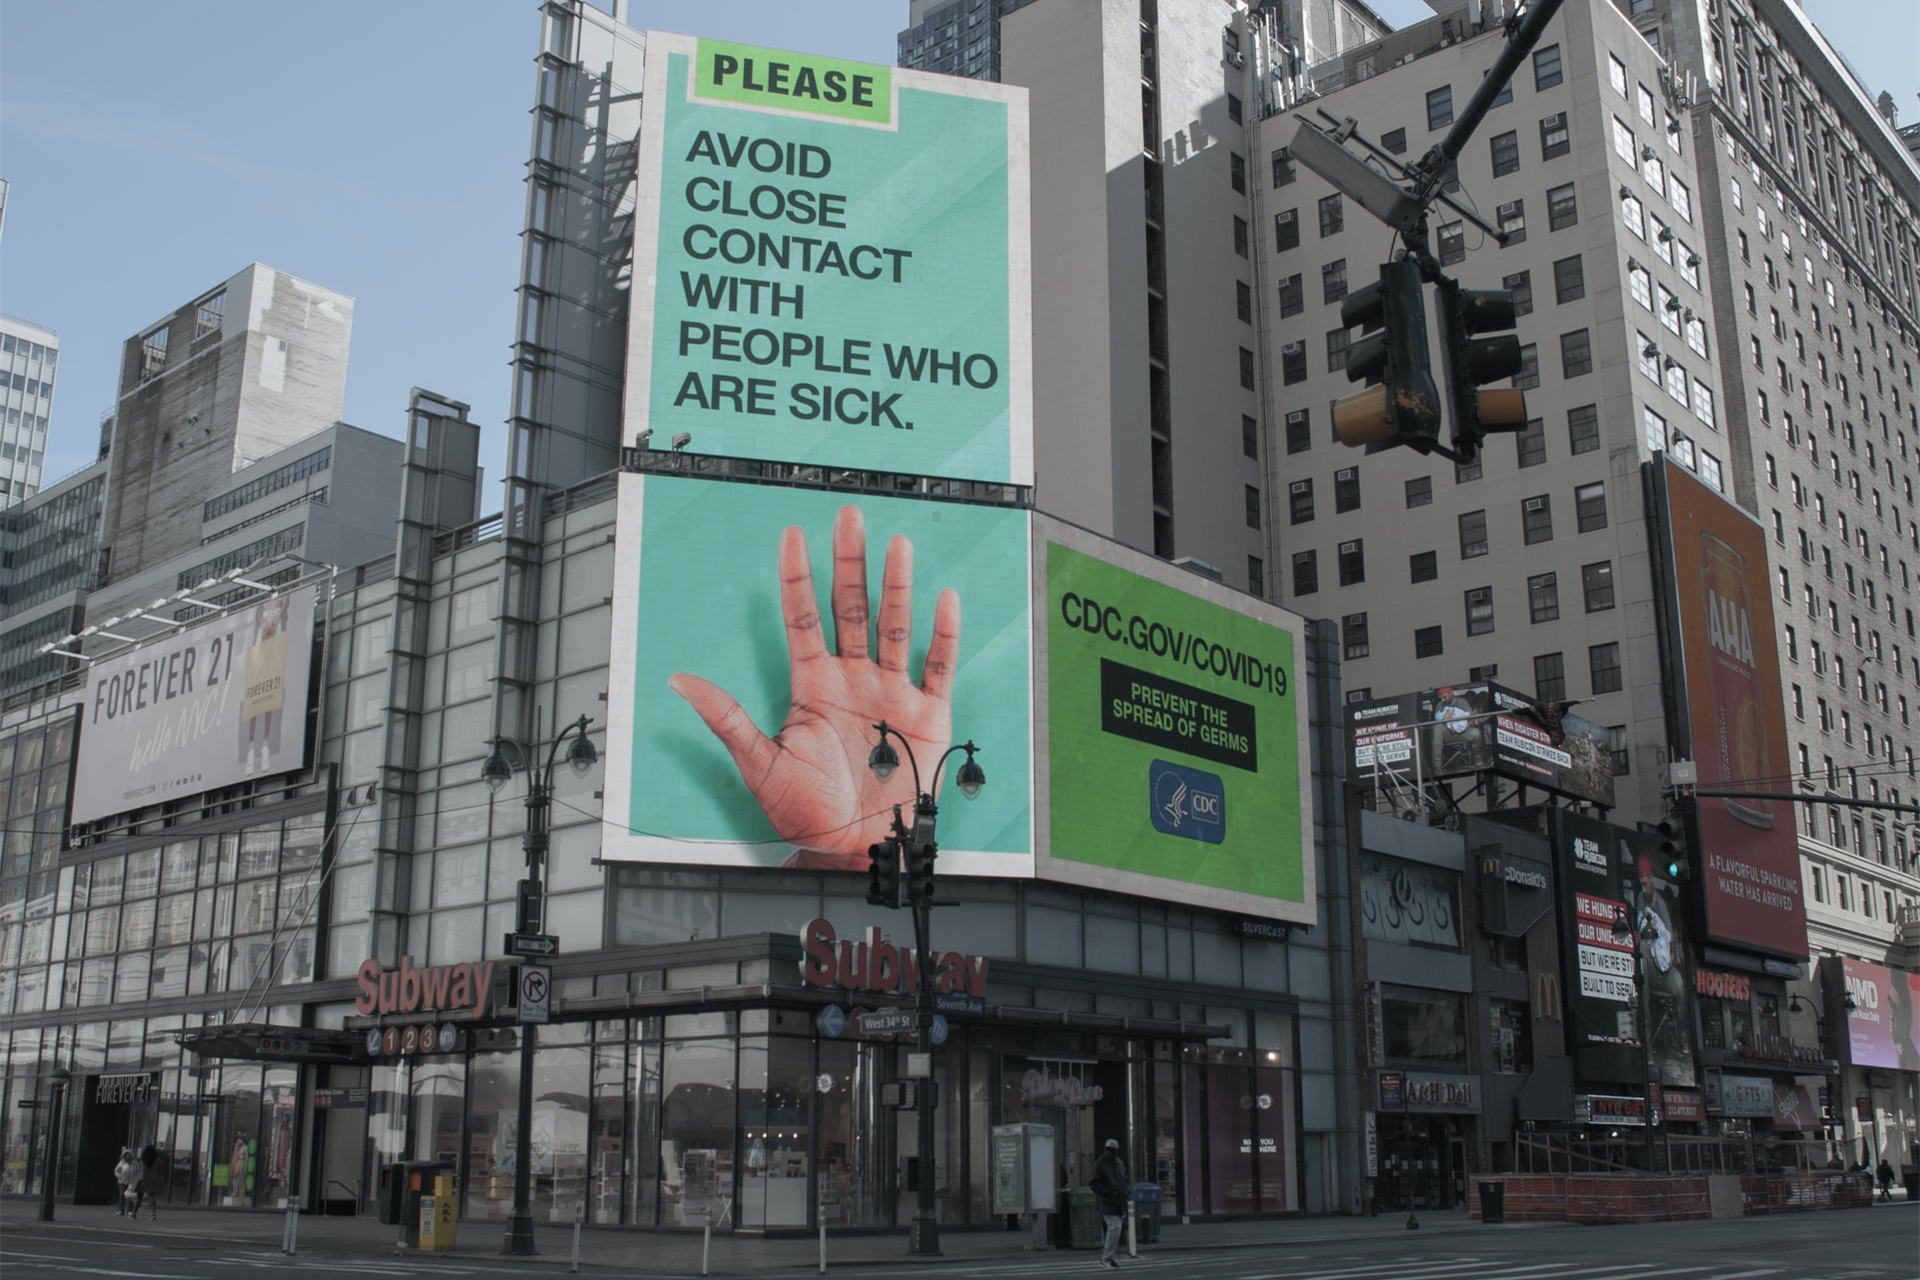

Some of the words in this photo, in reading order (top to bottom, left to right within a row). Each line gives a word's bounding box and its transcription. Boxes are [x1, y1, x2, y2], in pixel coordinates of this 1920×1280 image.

[713, 53, 873, 107] PLEASE
[685, 130, 831, 179] AVOID
[685, 176, 847, 229] CLOSE
[683, 224, 912, 283] CONTACT
[680, 271, 804, 320] WITH
[679, 320, 871, 376] PEOPLE
[882, 343, 998, 389] WHO
[673, 371, 776, 416] ARE
[789, 383, 914, 430] SICK.
[1709, 589, 1757, 669] AHA
[1061, 592, 1287, 697] CDC.GOV/COVID19
[93, 646, 196, 725] FOREVER
[207, 633, 234, 686] 21
[246, 681, 272, 699] FOREVER
[1131, 682, 1197, 718] PREVENT
[1201, 704, 1228, 729] THE
[1362, 707, 1376, 716] TEAM
[129, 714, 172, 772] hello
[175, 673, 232, 748] NYC!
[1113, 699, 1173, 732] SPREAD
[1177, 716, 1197, 739] OF
[1200, 723, 1248, 754] GERMS
[1498, 716, 1513, 730] WHEN
[1515, 722, 1538, 740] DISASTER
[1357, 737, 1370, 746] OUR
[1357, 748, 1369, 757] BUT
[1391, 741, 1409, 750] STILL
[1499, 732, 1513, 747] TEAM
[1513, 737, 1535, 754] RUBICON
[1537, 746, 1556, 761] STRIKES
[1557, 753, 1569, 765] BACK
[1193, 795, 1217, 815] CDC
[1583, 838, 1599, 853] TEAM
[1584, 850, 1607, 867] RUBICON
[1709, 853, 1715, 869] A
[1716, 855, 1760, 883] FLAVORFUL
[1760, 869, 1798, 895] SPARKLING
[1718, 876, 1745, 898] WATER
[1745, 884, 1761, 903] HAS
[1762, 890, 1793, 911] ARRIVED
[1577, 897, 1590, 914] WE
[1591, 900, 1614, 919] HUNG
[1243, 922, 1287, 938] SILVERCAST
[1579, 924, 1595, 941] OUR
[538, 942, 552, 950] WAY
[800, 918, 990, 997] Subway
[1581, 950, 1595, 967] BUT
[1597, 954, 1619, 972] WE'RE
[356, 956, 494, 1018] Subway
[1583, 976, 1603, 993] BUILT
[1604, 980, 1615, 995] TO
[1695, 969, 1751, 1002] HOOTERS
[936, 998, 966, 1010] Seventh
[967, 1003, 984, 1013] Ave
[1858, 1010, 1870, 1021] Music
[1869, 1012, 1880, 1025] Daily
[865, 1018, 885, 1028] West
[886, 1016, 901, 1028] 34th
[901, 1015, 910, 1027] St
[387, 1031, 394, 1050] 1
[405, 1030, 415, 1049] 2
[423, 1029, 433, 1047] 3
[1737, 1014, 1797, 1065] Subway
[96, 1083, 136, 1104] FOREVER
[138, 1083, 150, 1103] 21
[1407, 1081, 1440, 1104] A&H
[1444, 1083, 1473, 1104] Deli
[1599, 1101, 1622, 1114] NYC
